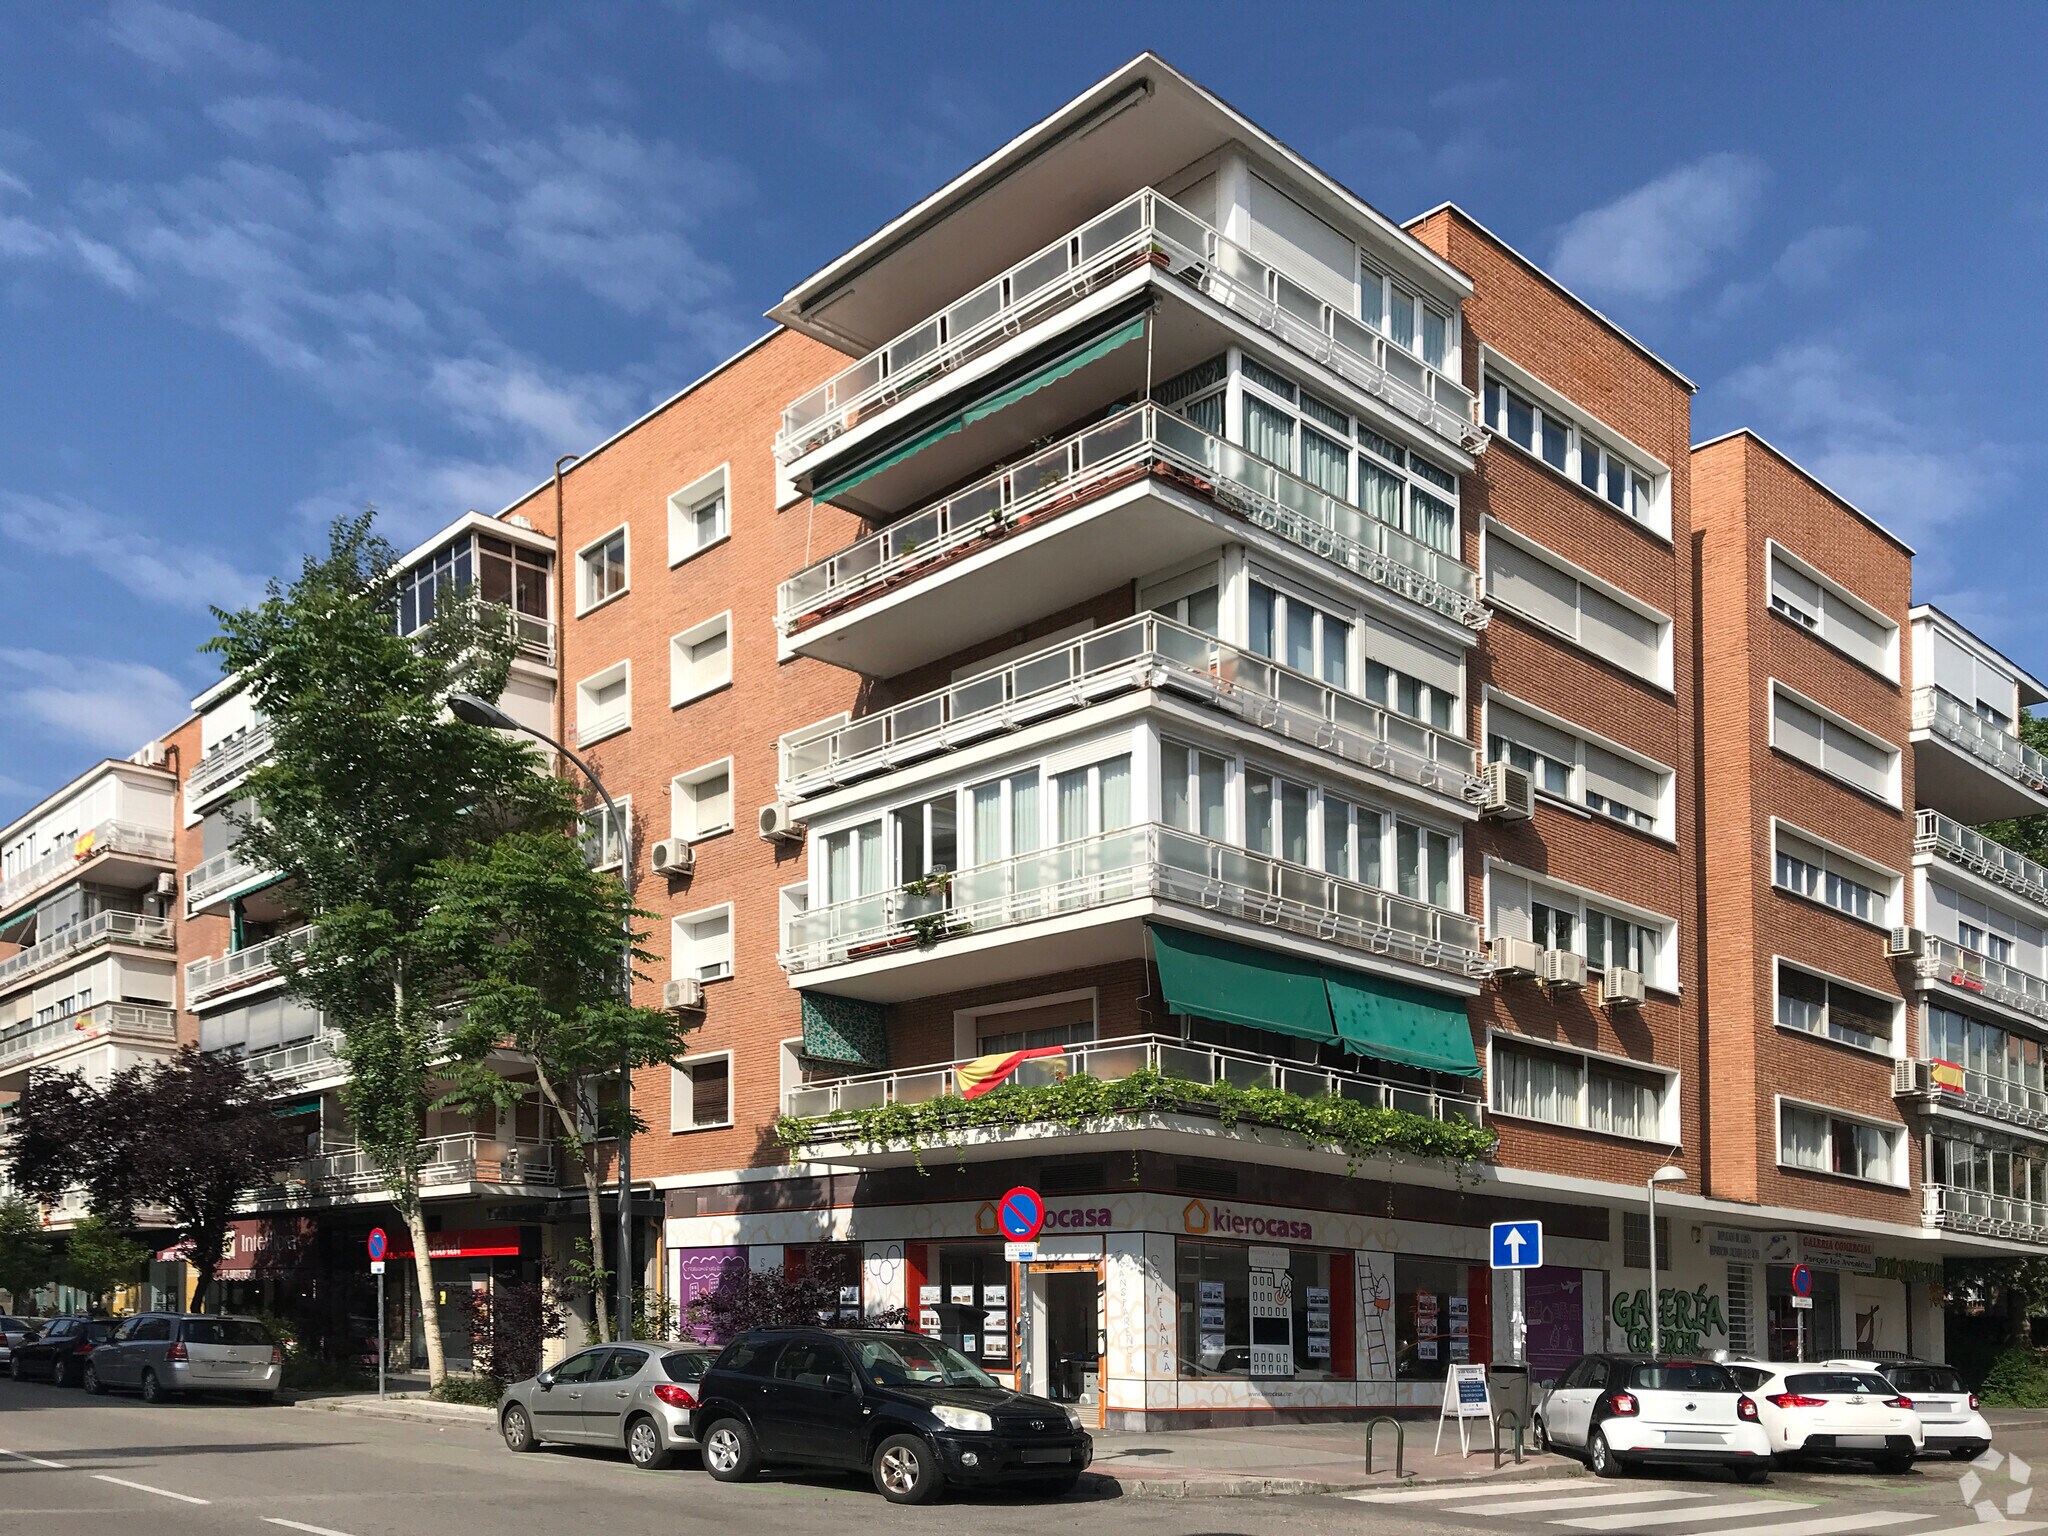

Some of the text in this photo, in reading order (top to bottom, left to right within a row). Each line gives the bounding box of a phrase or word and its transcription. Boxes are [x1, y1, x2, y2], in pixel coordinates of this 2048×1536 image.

[1044, 1208, 1112, 1228] ocasa
[1213, 1206, 1312, 1239] kierocasa
[1803, 1236, 1872, 1255] GALERIA COMERCIAL
